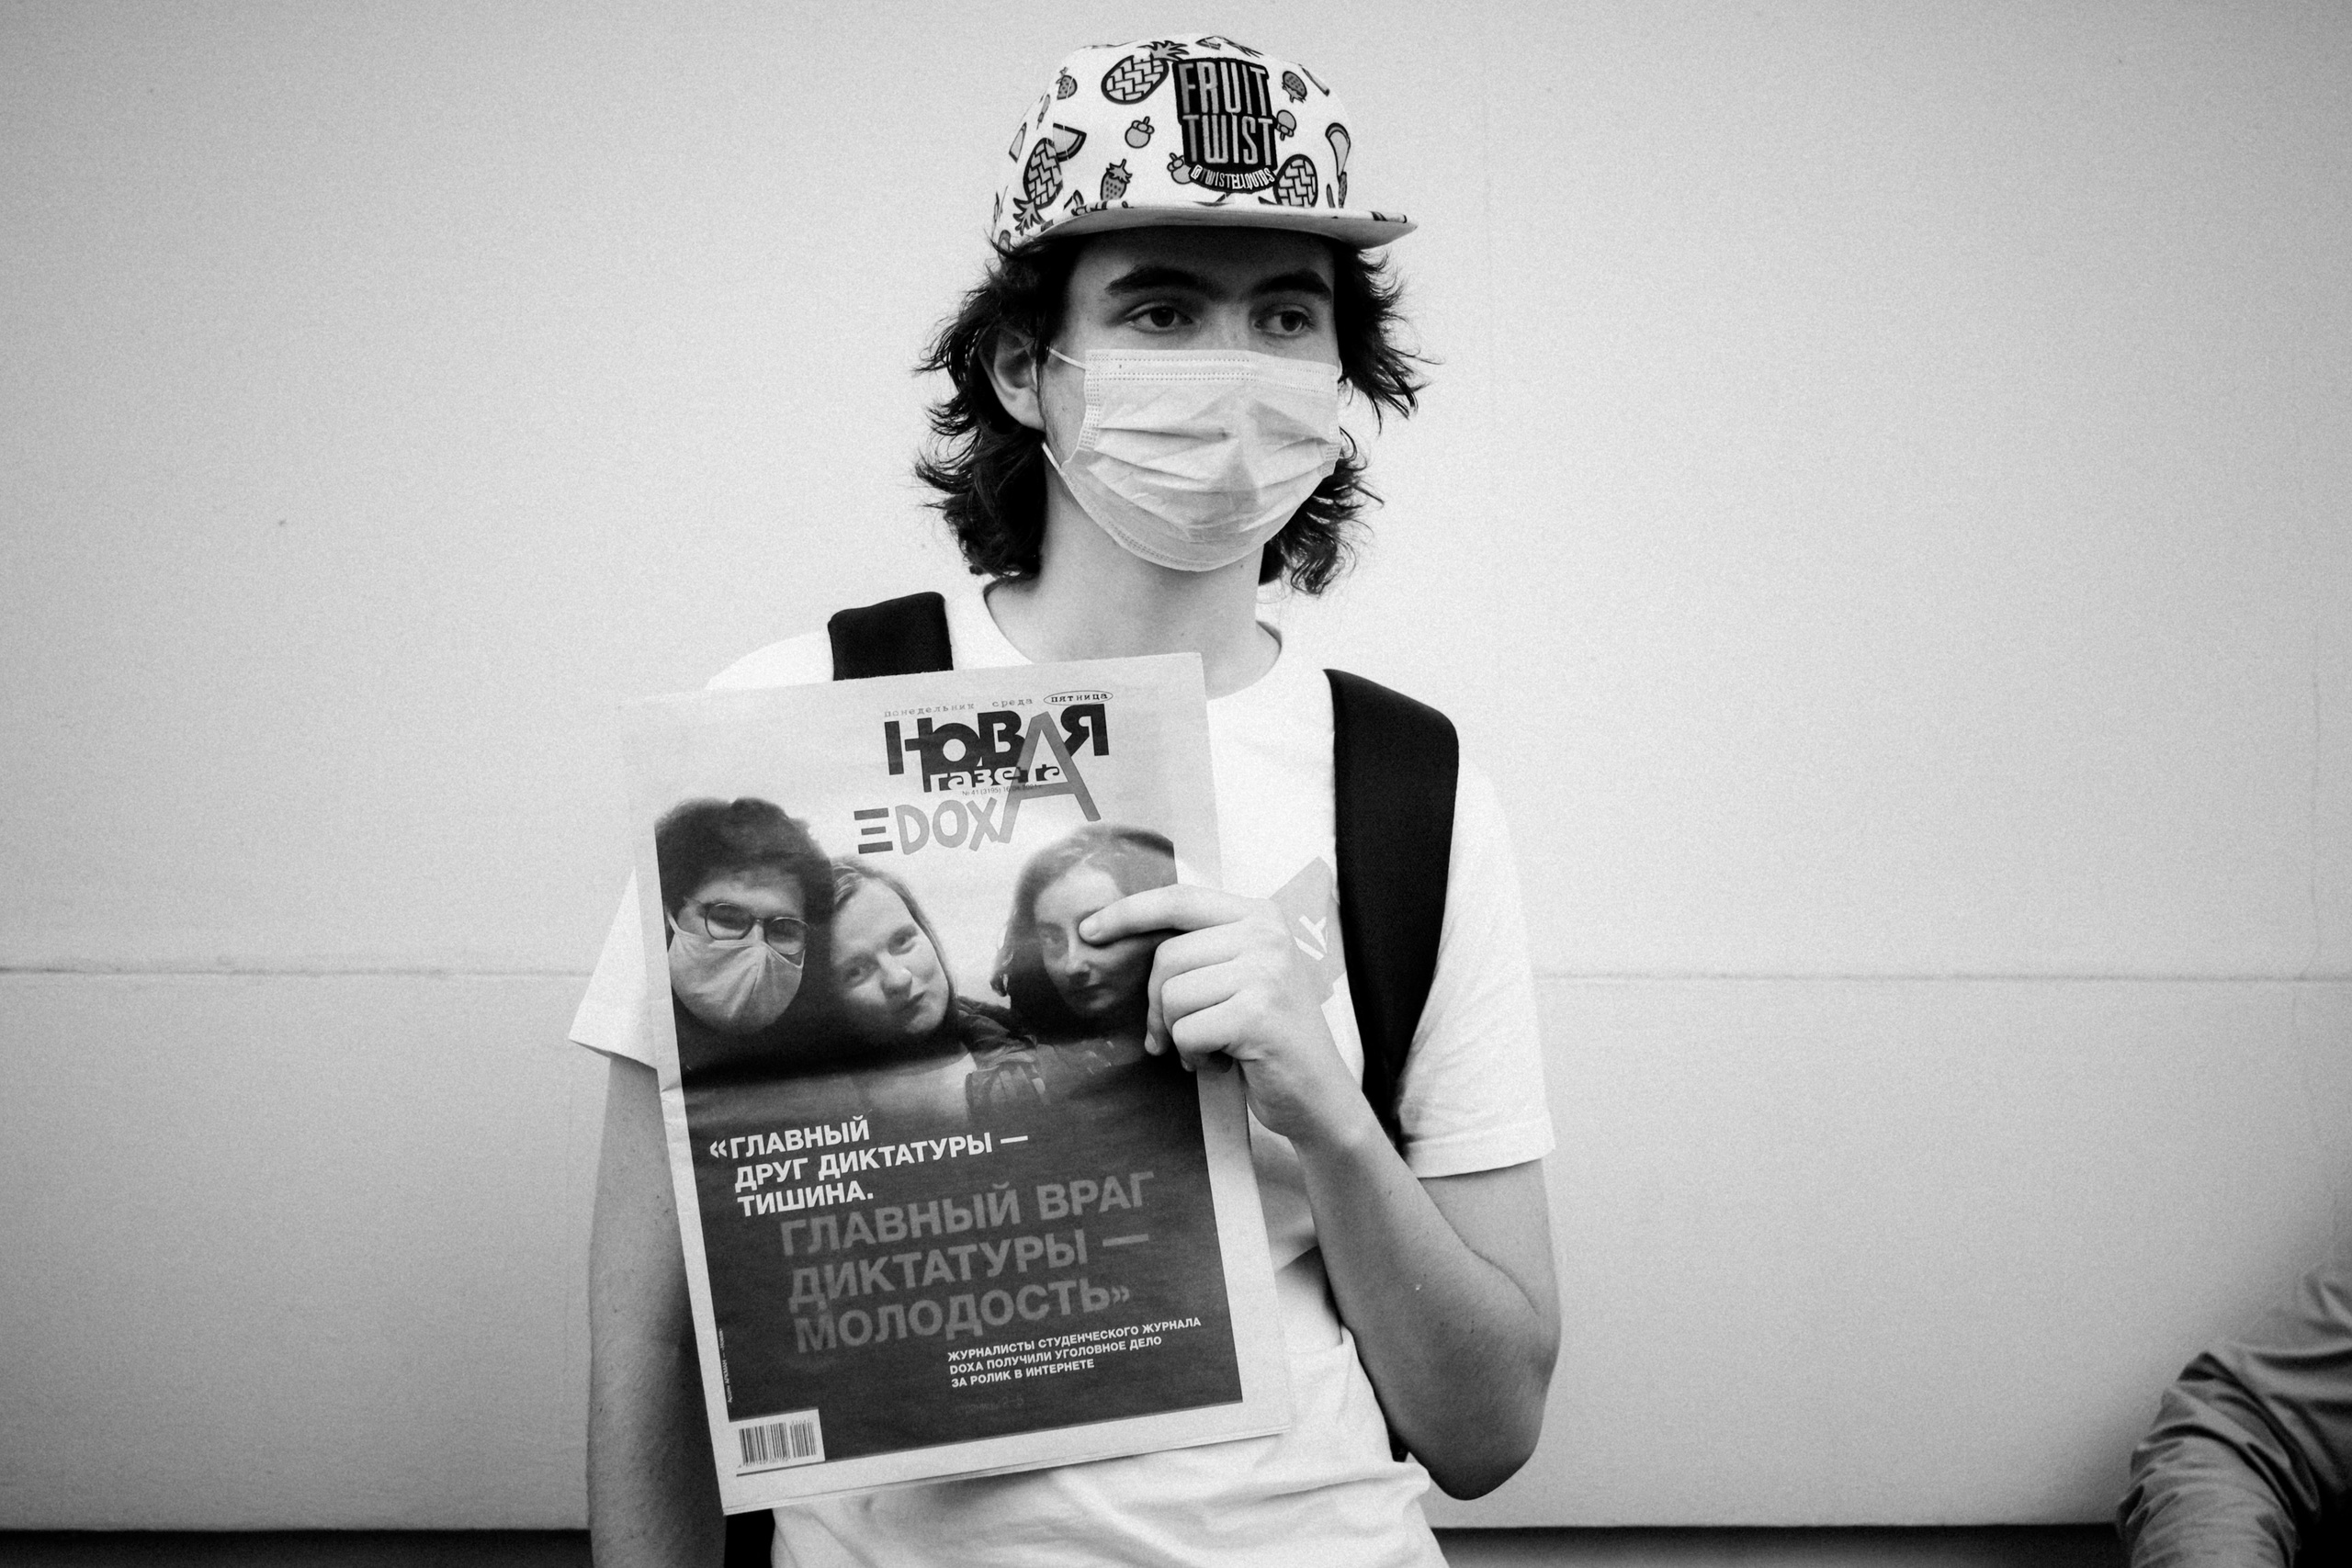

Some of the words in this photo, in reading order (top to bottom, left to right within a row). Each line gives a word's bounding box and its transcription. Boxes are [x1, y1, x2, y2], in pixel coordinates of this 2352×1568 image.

[1178, 61, 1267, 117] FRUIT
[1182, 113, 1273, 166] TWIST
[883, 702, 976, 718] понедельник
[991, 697, 1035, 708] среда
[1050, 692, 1109, 705] пятница
[980, 786, 1002, 796] (3195)
[709, 1114, 871, 1160] «ГЛАВНЫЙ
[734, 1157, 808, 1194] ДРУГ
[818, 1132, 993, 1181] ДИКТАТУРЫ
[737, 1179, 875, 1218] ТИШИНА.
[780, 1181, 1023, 1258] ГЛАВНЫЙ
[1035, 1170, 1155, 1222] ВРАГ
[787, 1228, 1089, 1314] ДИКТАТУРЫ
[793, 1277, 1131, 1355] МОЛОДОСТЬ»
[946, 1340, 1035, 1362] ЖУРНАЛИСТЫ
[1037, 1325, 1139, 1349] СТУДЕНЧЕСКОГО
[1141, 1316, 1202, 1335] ЖУРНАЛА
[951, 1377, 968, 1388] ЗА
[969, 1371, 1012, 1386] РОЛИК
[1013, 1369, 1023, 1379] В
[1025, 1359, 1095, 1378] ИНТЕРНЕТЕ
[986, 1351, 1053, 1371] ПОЛУЧИЛИ
[1055, 1340, 1127, 1360] УГОЛОВНОЕ
[1128, 1336, 1163, 1352] ДЕЛО
